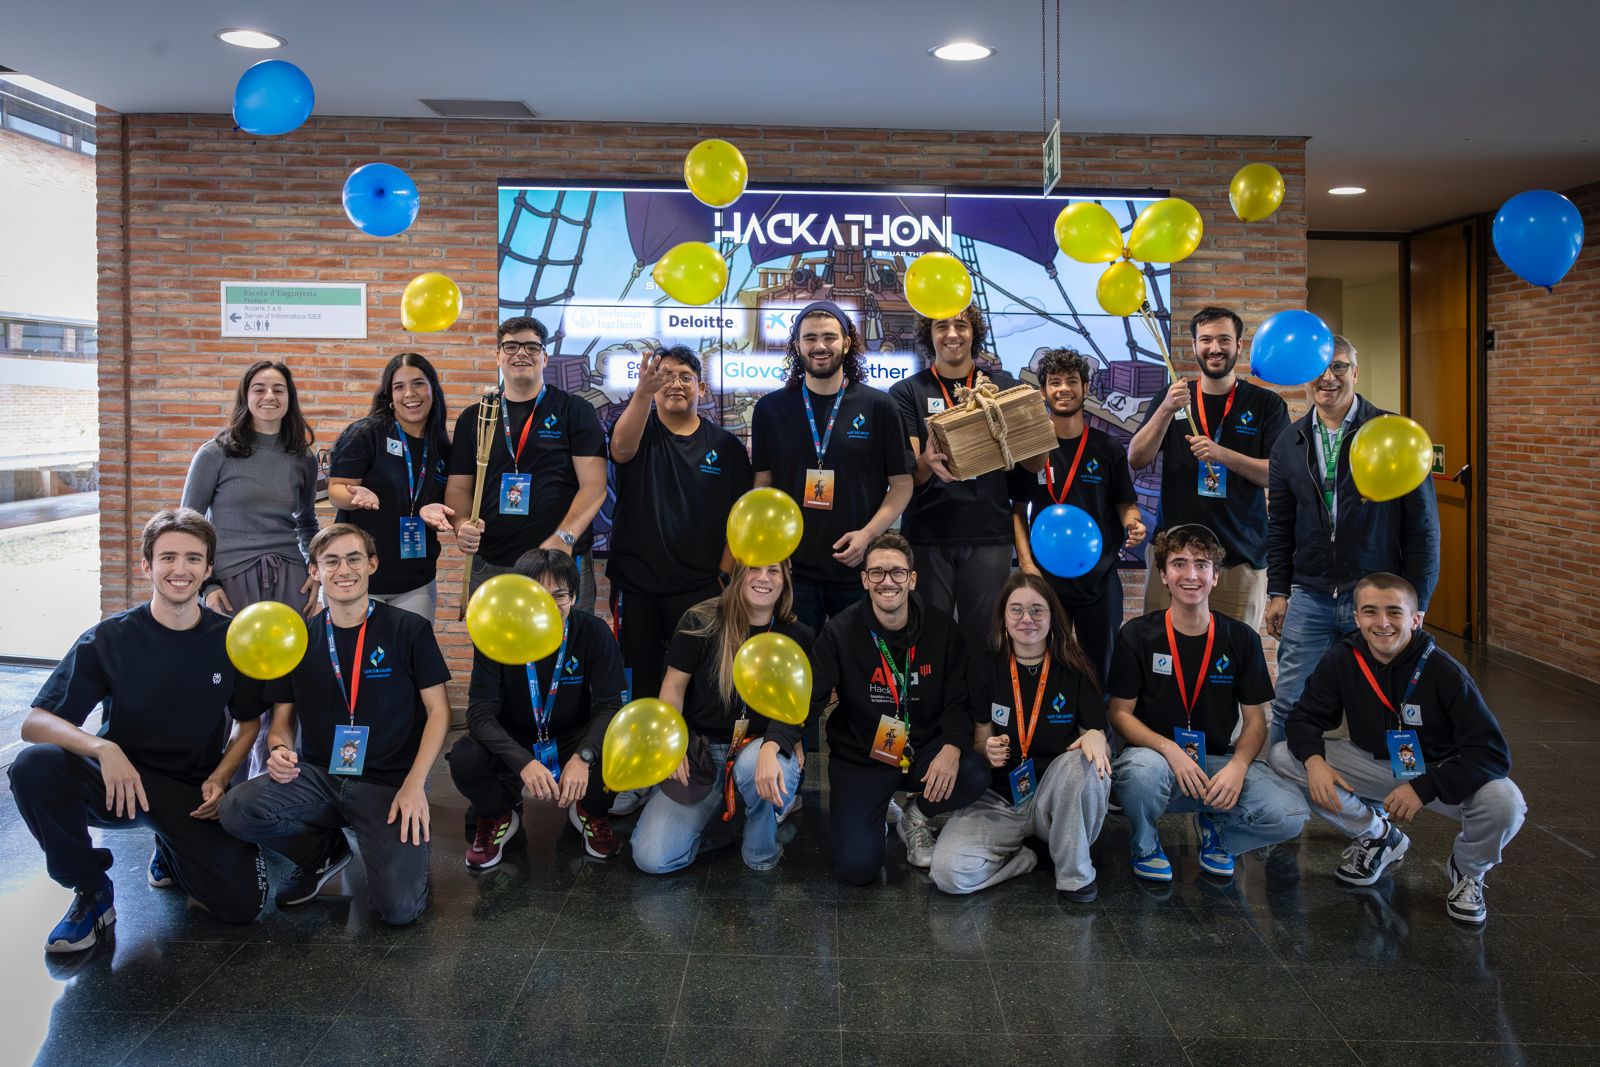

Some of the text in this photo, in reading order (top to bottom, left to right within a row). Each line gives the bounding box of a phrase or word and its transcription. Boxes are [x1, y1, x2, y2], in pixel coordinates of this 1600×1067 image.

[714, 212, 952, 247] HACKATHON
[269, 289, 316, 298] d'Enginyeria
[597, 307, 646, 319] Boehringer
[597, 319, 642, 330] Ingelheim
[724, 361, 784, 380] Glovo
